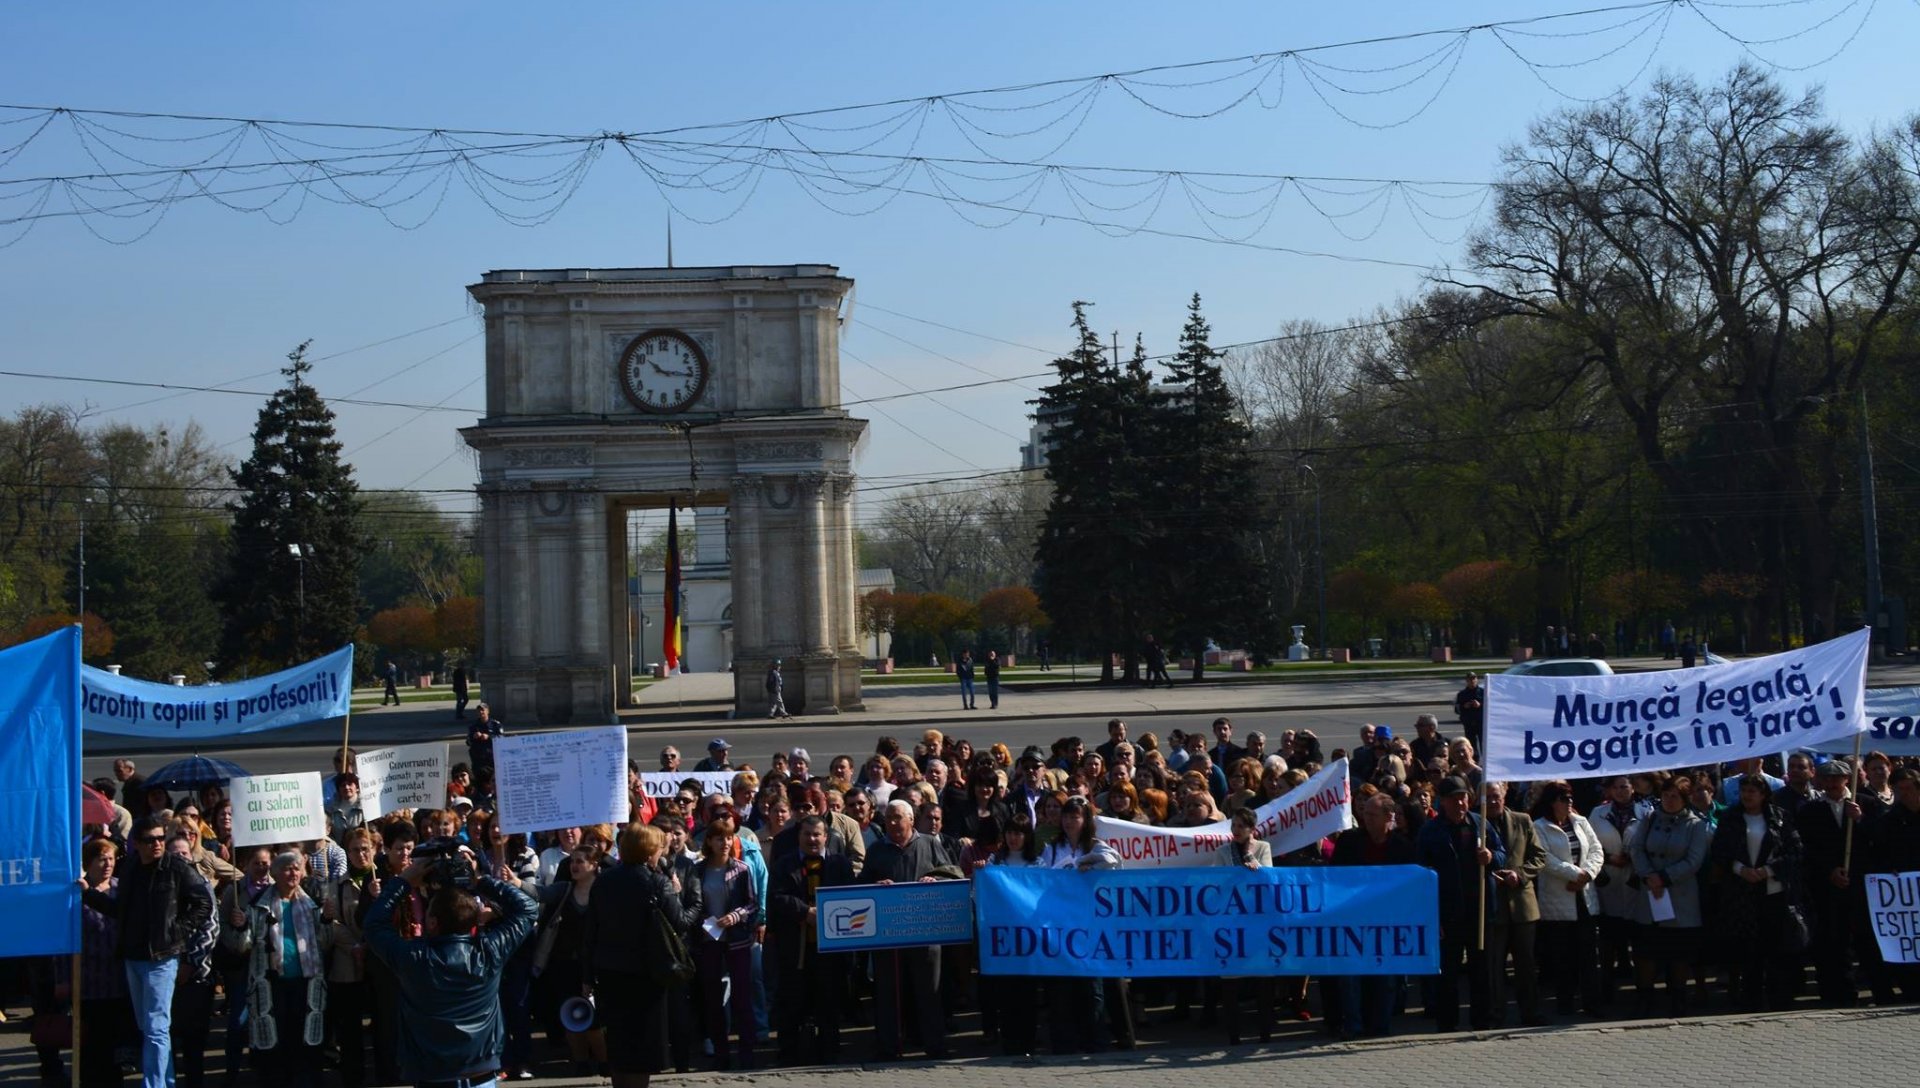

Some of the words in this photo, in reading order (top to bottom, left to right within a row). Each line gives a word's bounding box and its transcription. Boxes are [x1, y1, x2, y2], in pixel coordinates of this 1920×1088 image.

[646, 344, 653, 355] 11
[659, 340, 668, 351] 12
[674, 344, 679, 355] 1
[636, 353, 645, 364] 10
[683, 353, 690, 364] 2
[633, 367, 640, 378] 9
[637, 379, 643, 391] 8
[647, 389, 653, 400] 7
[660, 392, 667, 403] 6
[675, 389, 681, 400] 5
[1553, 685, 1681, 728] Muncă
[152, 700, 207, 729] copiii
[214, 697, 229, 725] și
[1524, 723, 1678, 771] bogăție
[1690, 718, 1732, 749] în
[415, 771, 424, 779] pe
[264, 777, 299, 793] Europa
[248, 799, 262, 813] cu
[266, 794, 303, 811] salarii
[1106, 834, 1179, 865] DUCAȚIA
[1094, 884, 1322, 918] SINDICATUL
[1875, 910, 1920, 937] ESTE
[989, 925, 1194, 970] EDUCAȚIEI
[1214, 927, 1248, 968] ȘI
[1268, 925, 1430, 968] ȘTIINȚEI
